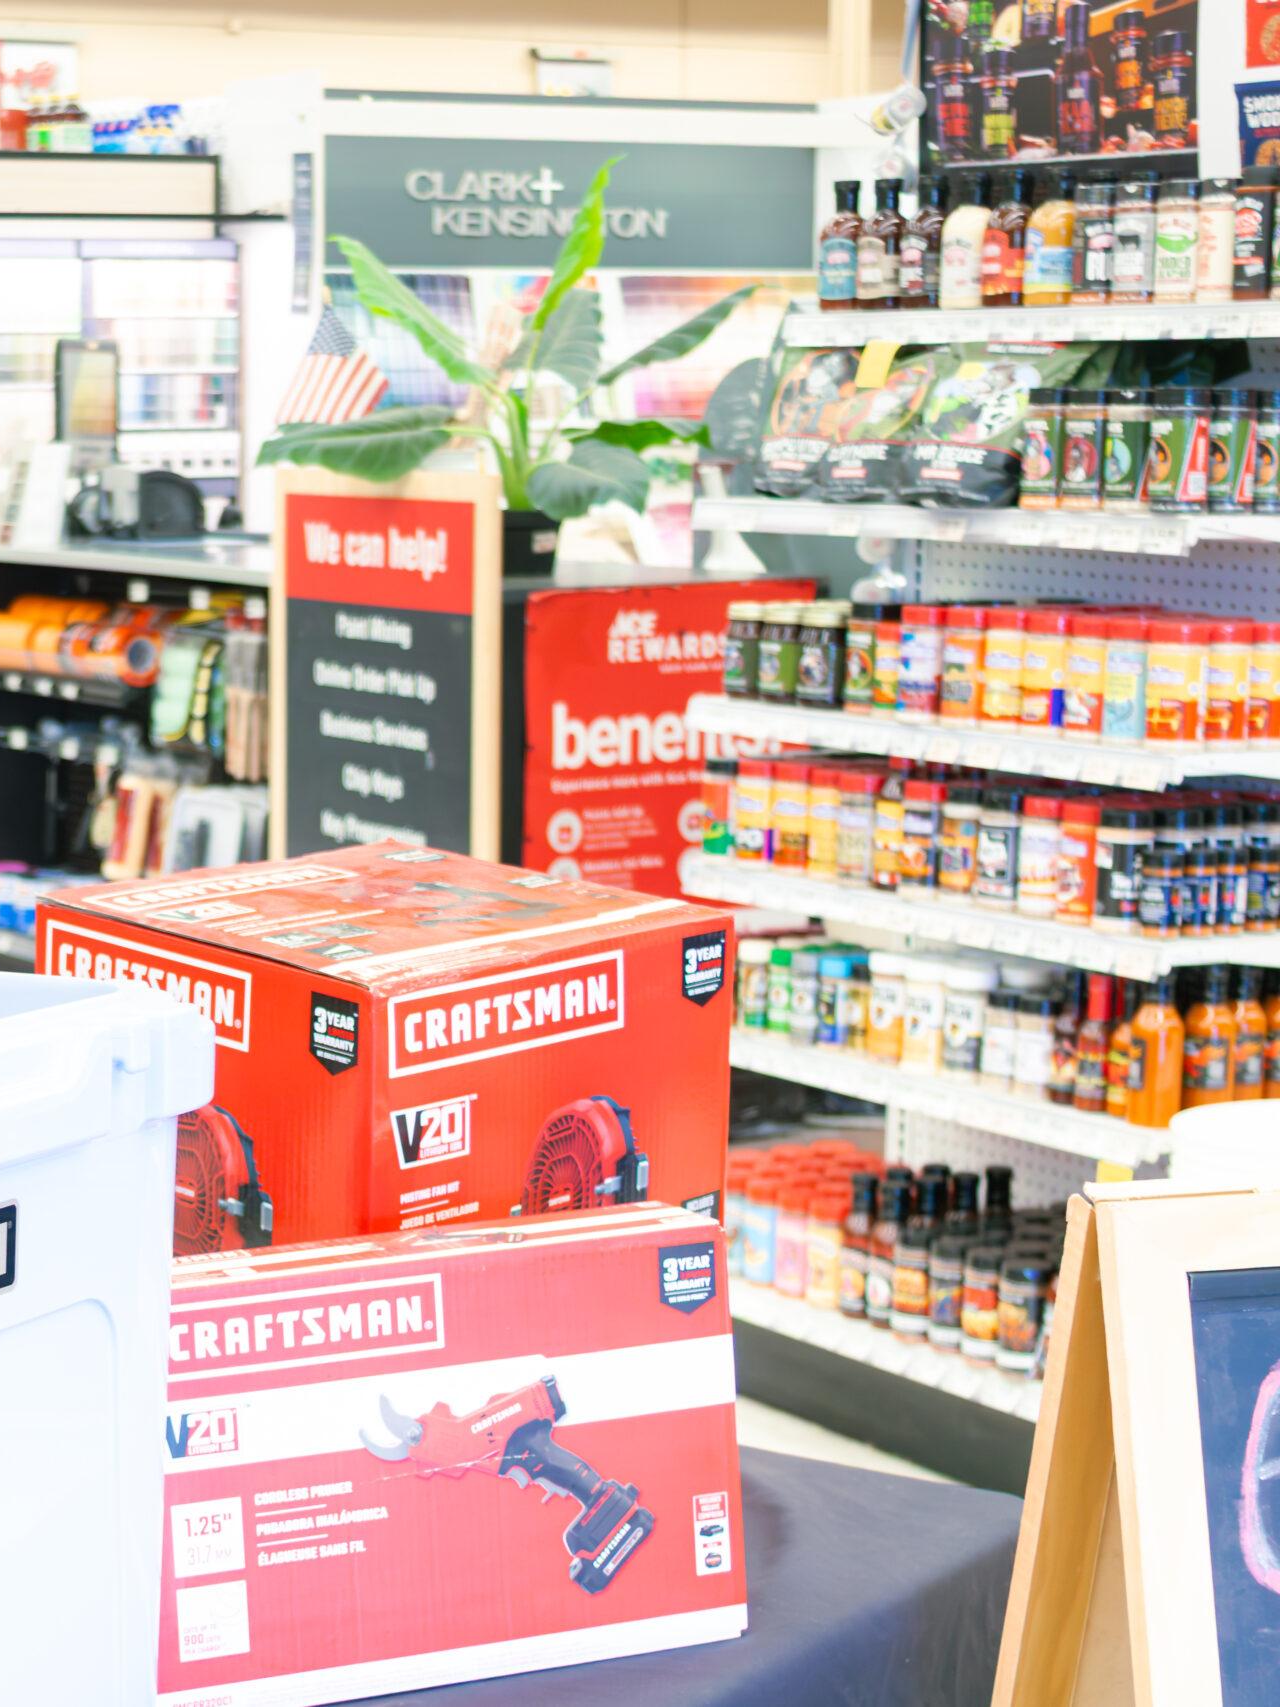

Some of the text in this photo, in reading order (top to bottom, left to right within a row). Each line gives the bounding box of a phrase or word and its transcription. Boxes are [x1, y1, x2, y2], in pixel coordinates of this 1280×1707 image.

[304, 521, 448, 581] We can help!
[609, 612, 657, 638] ACE
[113, 868, 329, 906] CRAFTSMAN
[684, 943, 723, 975] 3 YEAR
[313, 1006, 356, 1034] 3 YEAR
[404, 973, 610, 1054] CRAFTSMAN
[395, 1102, 465, 1165] V20
[663, 1254, 711, 1283] 3 YEAR
[169, 1295, 423, 1362] CRAFTSMAN
[166, 1408, 236, 1459] V20
[470, 1402, 523, 1435] CRAFTSMAN
[254, 1480, 353, 1506] CORDLESS PRUNER
[318, 1541, 349, 1559] SANS
[349, 1539, 367, 1554] FIL
[592, 1522, 632, 1569] CRAFTSMAN
[183, 1634, 205, 1647] 900
